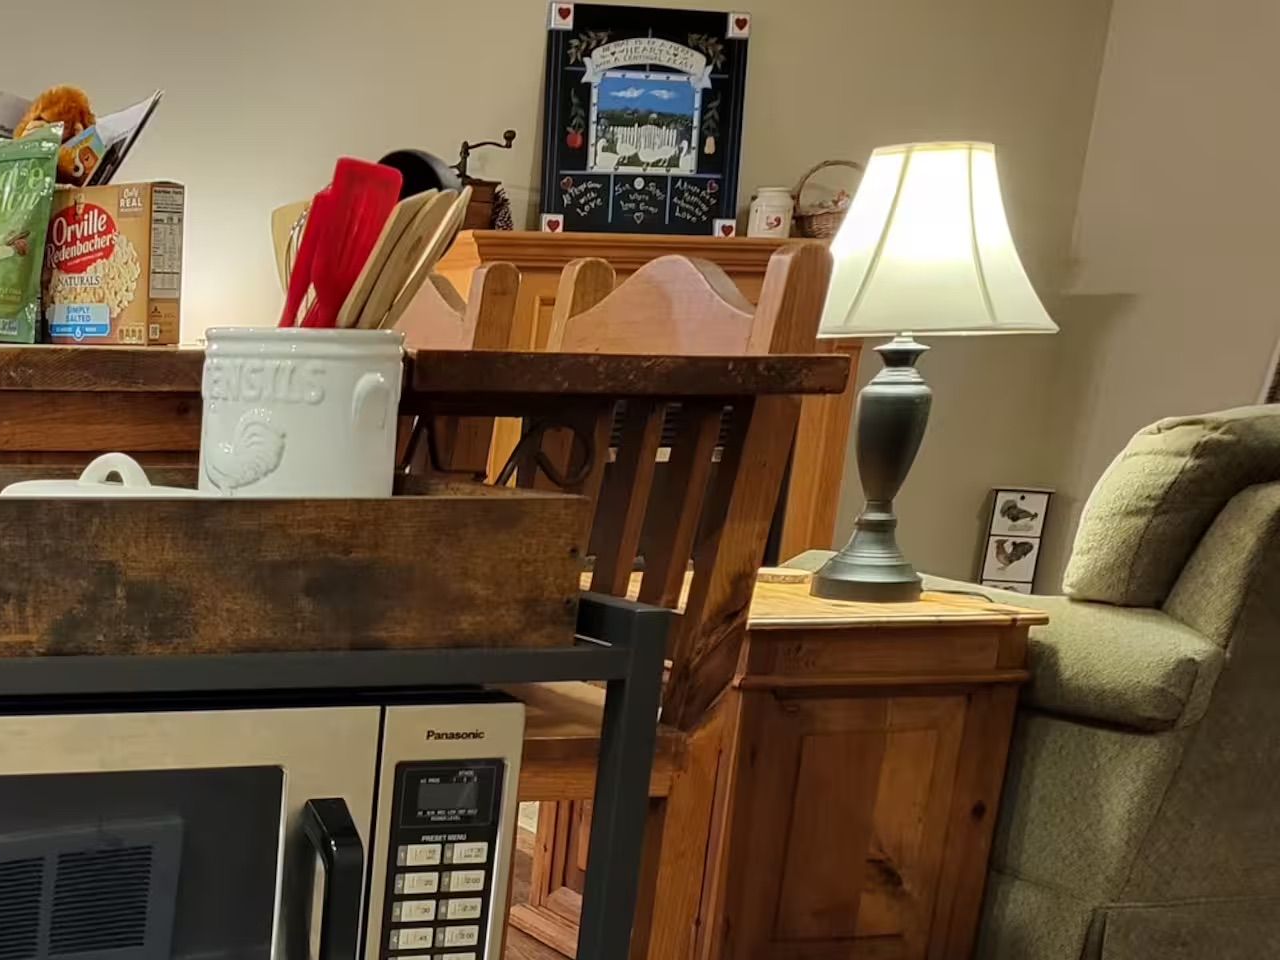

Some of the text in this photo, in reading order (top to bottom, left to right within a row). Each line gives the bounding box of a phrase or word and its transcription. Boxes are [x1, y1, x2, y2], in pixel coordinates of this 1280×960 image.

[120, 198, 142, 207] REAL
[53, 209, 107, 246] Orville
[59, 275, 100, 288] NATURALS
[426, 728, 485, 741] Panasonic
